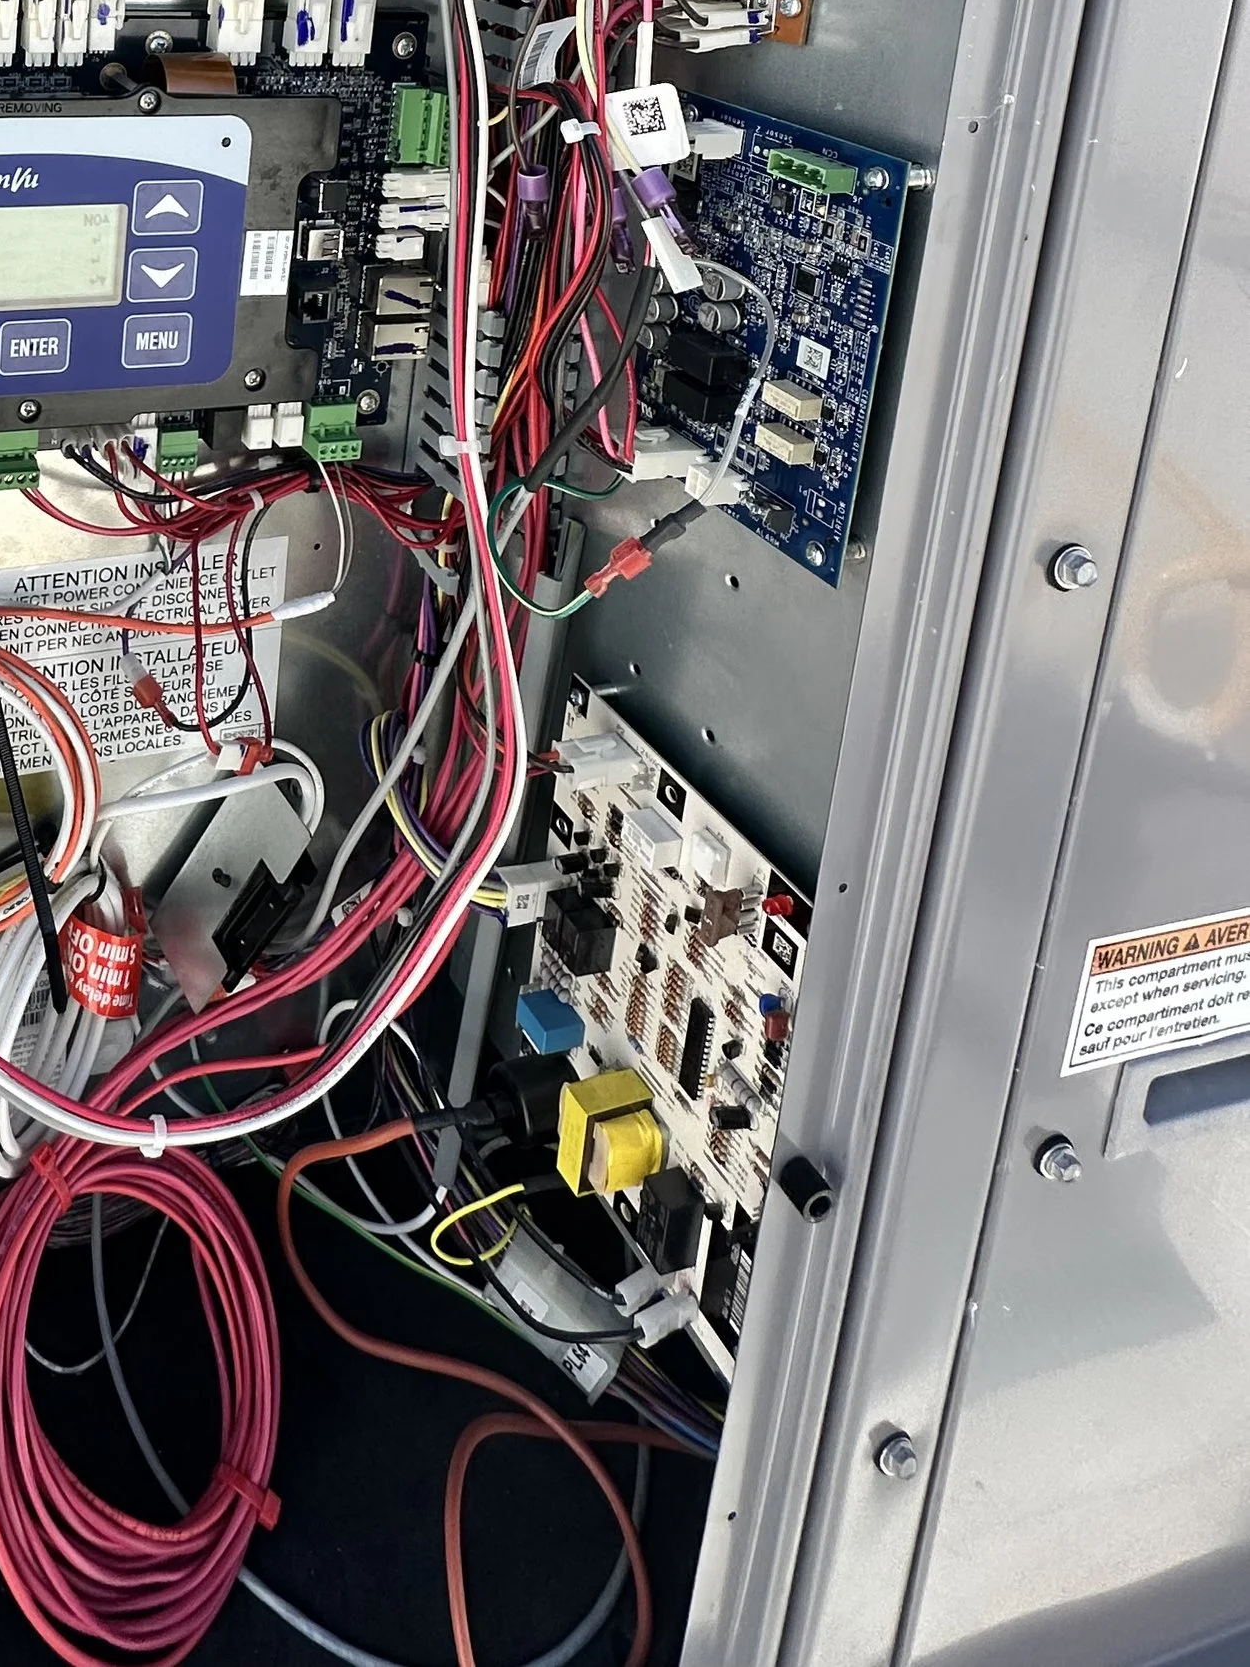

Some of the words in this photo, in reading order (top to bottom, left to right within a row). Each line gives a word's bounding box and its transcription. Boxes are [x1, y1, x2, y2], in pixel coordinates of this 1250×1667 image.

[10, 336, 59, 358] ENTER
[136, 331, 178, 352] MENU
[14, 565, 128, 594] ATTENTION
[54, 586, 108, 604] POWER
[38, 638, 68, 652] PER
[72, 632, 102, 647] NEC
[72, 677, 99, 691] LES
[162, 665, 178, 678] LA
[80, 688, 120, 704] CÔTÉ
[81, 703, 120, 718] LORS
[98, 940, 130, 963] min
[130, 943, 136, 965] 5
[1099, 936, 1180, 969] WARNING
[90, 958, 124, 987] min
[124, 970, 130, 990] 1
[1096, 978, 1124, 994] This
[1128, 956, 1222, 986] compartment
[76, 978, 111, 1009] delay
[1090, 991, 1139, 1014] except
[1142, 983, 1179, 1002] when
[1183, 970, 1247, 992] servicing.
[1084, 1022, 1104, 1038] Ce
[1107, 998, 1204, 1032] compartiment
[1207, 992, 1234, 1008] doit
[1079, 1036, 1112, 1056] sauf
[1113, 1030, 1147, 1050] pour
[1149, 1014, 1221, 1039] l'entretien.
[562, 1342, 592, 1378] PL64
